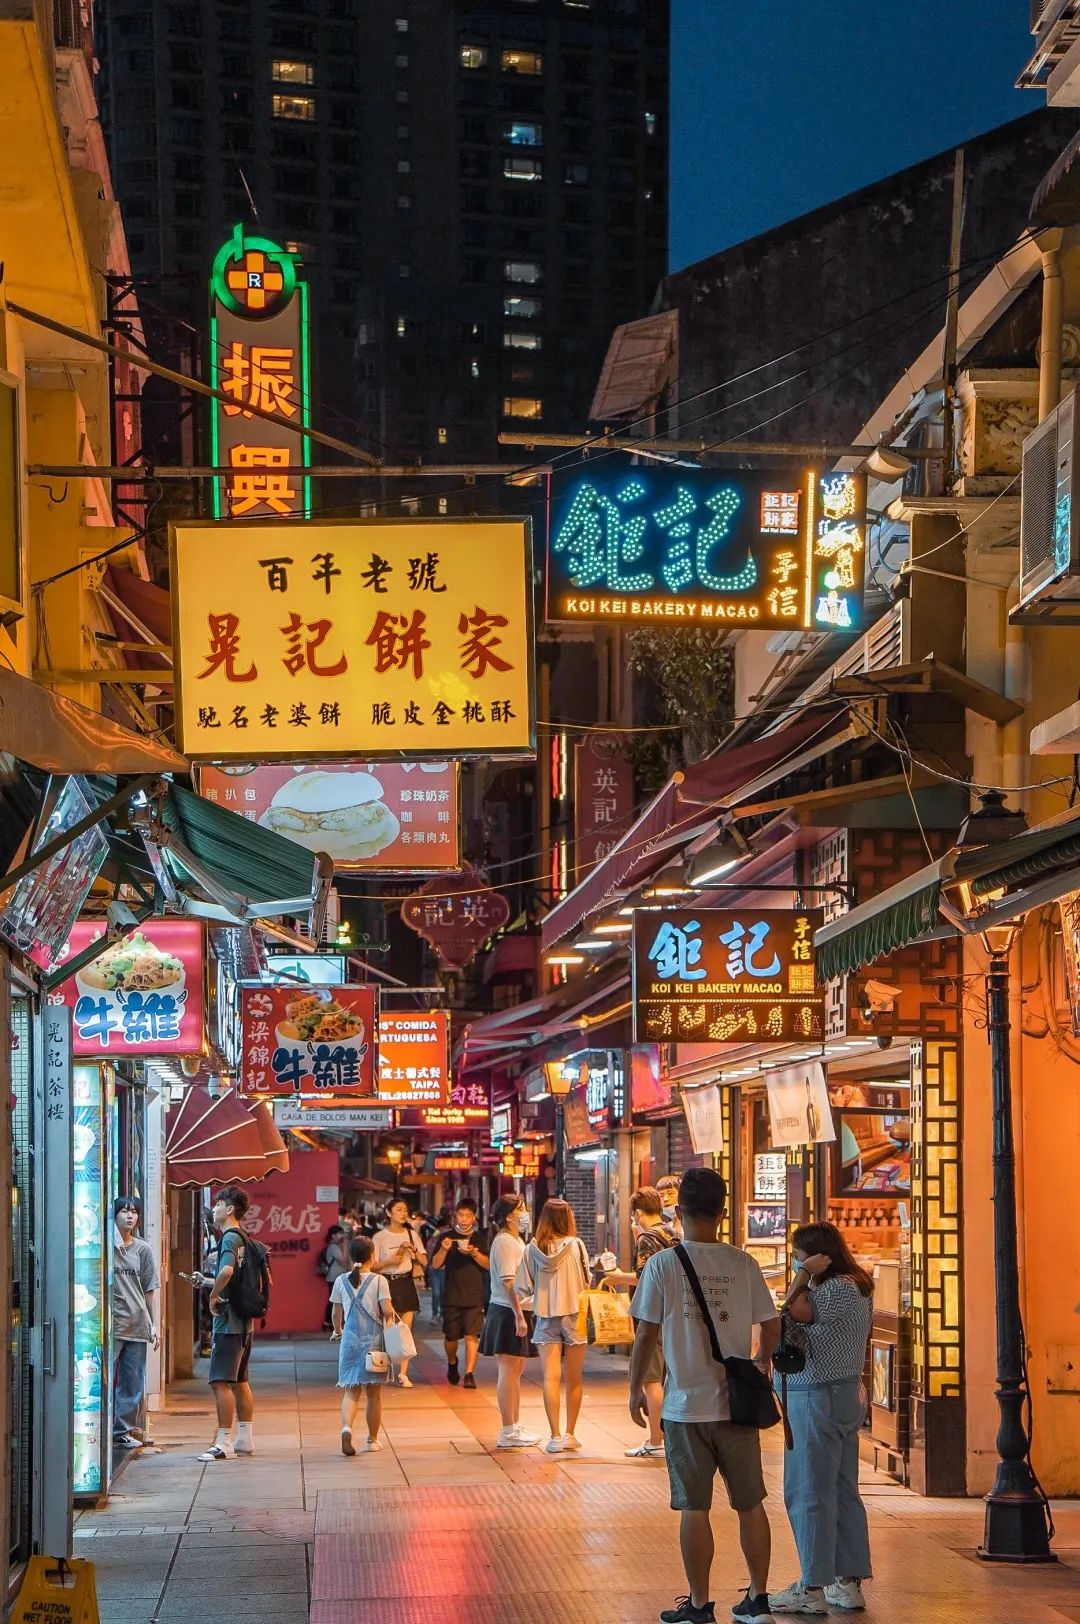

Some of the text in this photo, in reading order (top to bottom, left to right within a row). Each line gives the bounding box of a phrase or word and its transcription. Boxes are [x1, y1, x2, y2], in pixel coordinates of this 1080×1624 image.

[554, 483, 757, 592] 鉅記
[258, 552, 448, 595] 百年老號
[767, 551, 799, 616] 手信
[567, 598, 759, 619] KOI KEI BAKERY MACAO
[196, 604, 515, 683] 晃記餅家
[196, 701, 342, 729] 馳名老婆餅
[400, 789, 450, 802] 珍珠奶茶
[400, 810, 450, 824] 咖啡
[400, 831, 450, 844] 各類肉丸
[648, 920, 781, 980] 鉅記
[791, 917, 812, 960] 手信
[652, 983, 782, 994] KOI KEI BAKERY MACAO
[75, 992, 181, 1044] 牛雜
[395, 1021, 438, 1030] COMIDA
[247, 1021, 270, 1091] 梁錦記
[272, 1044, 362, 1091] 牛雜
[47, 1022, 65, 1121] 晃記茶樓
[410, 1080, 441, 1089] TAIPA
[281, 1113, 383, 1121] CASA DE BOLOS MAN KEI
[23, 1611, 42, 1623] WET
[31, 1601, 70, 1614] CAUTION
